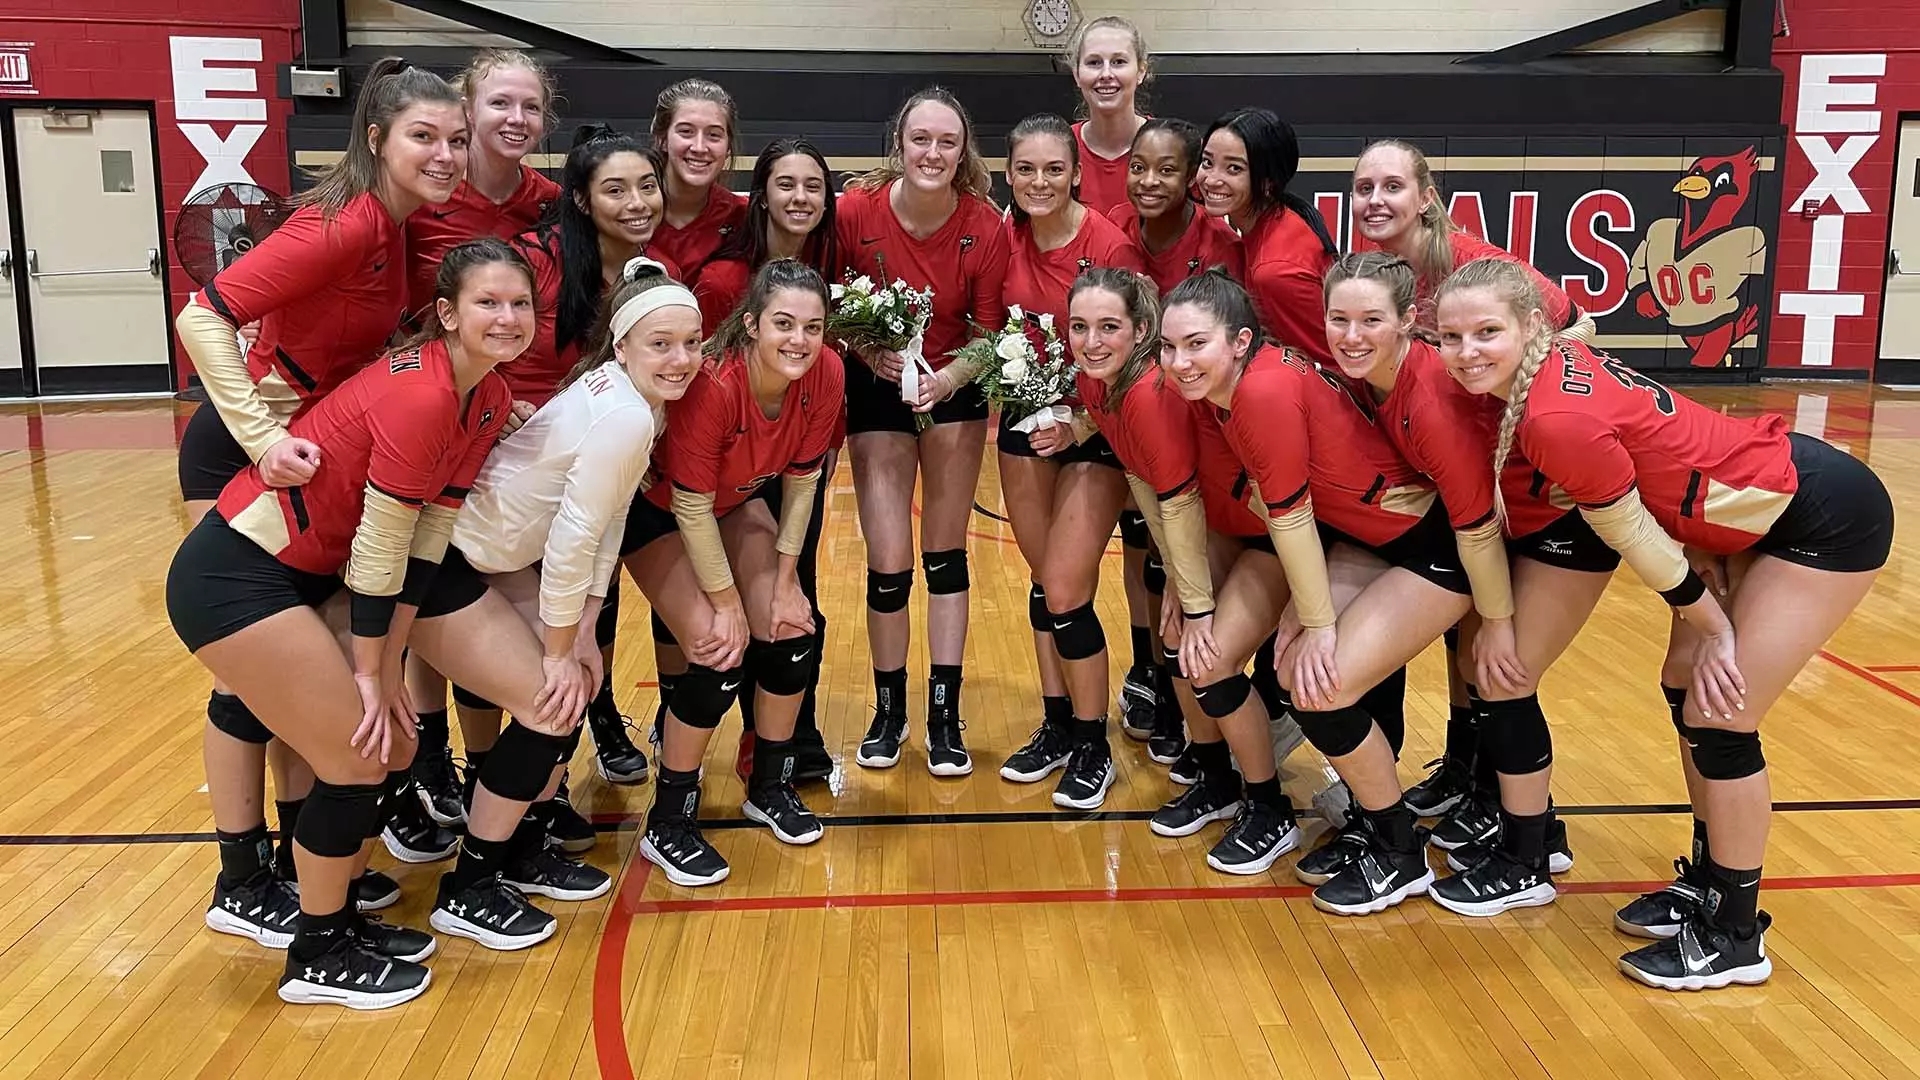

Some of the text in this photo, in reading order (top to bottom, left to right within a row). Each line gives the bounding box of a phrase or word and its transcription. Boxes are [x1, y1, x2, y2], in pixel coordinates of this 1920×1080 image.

[0, 55, 20, 79] XIT
[1780, 54, 1887, 366] EXIT
[1656, 263, 1716, 307] OC
